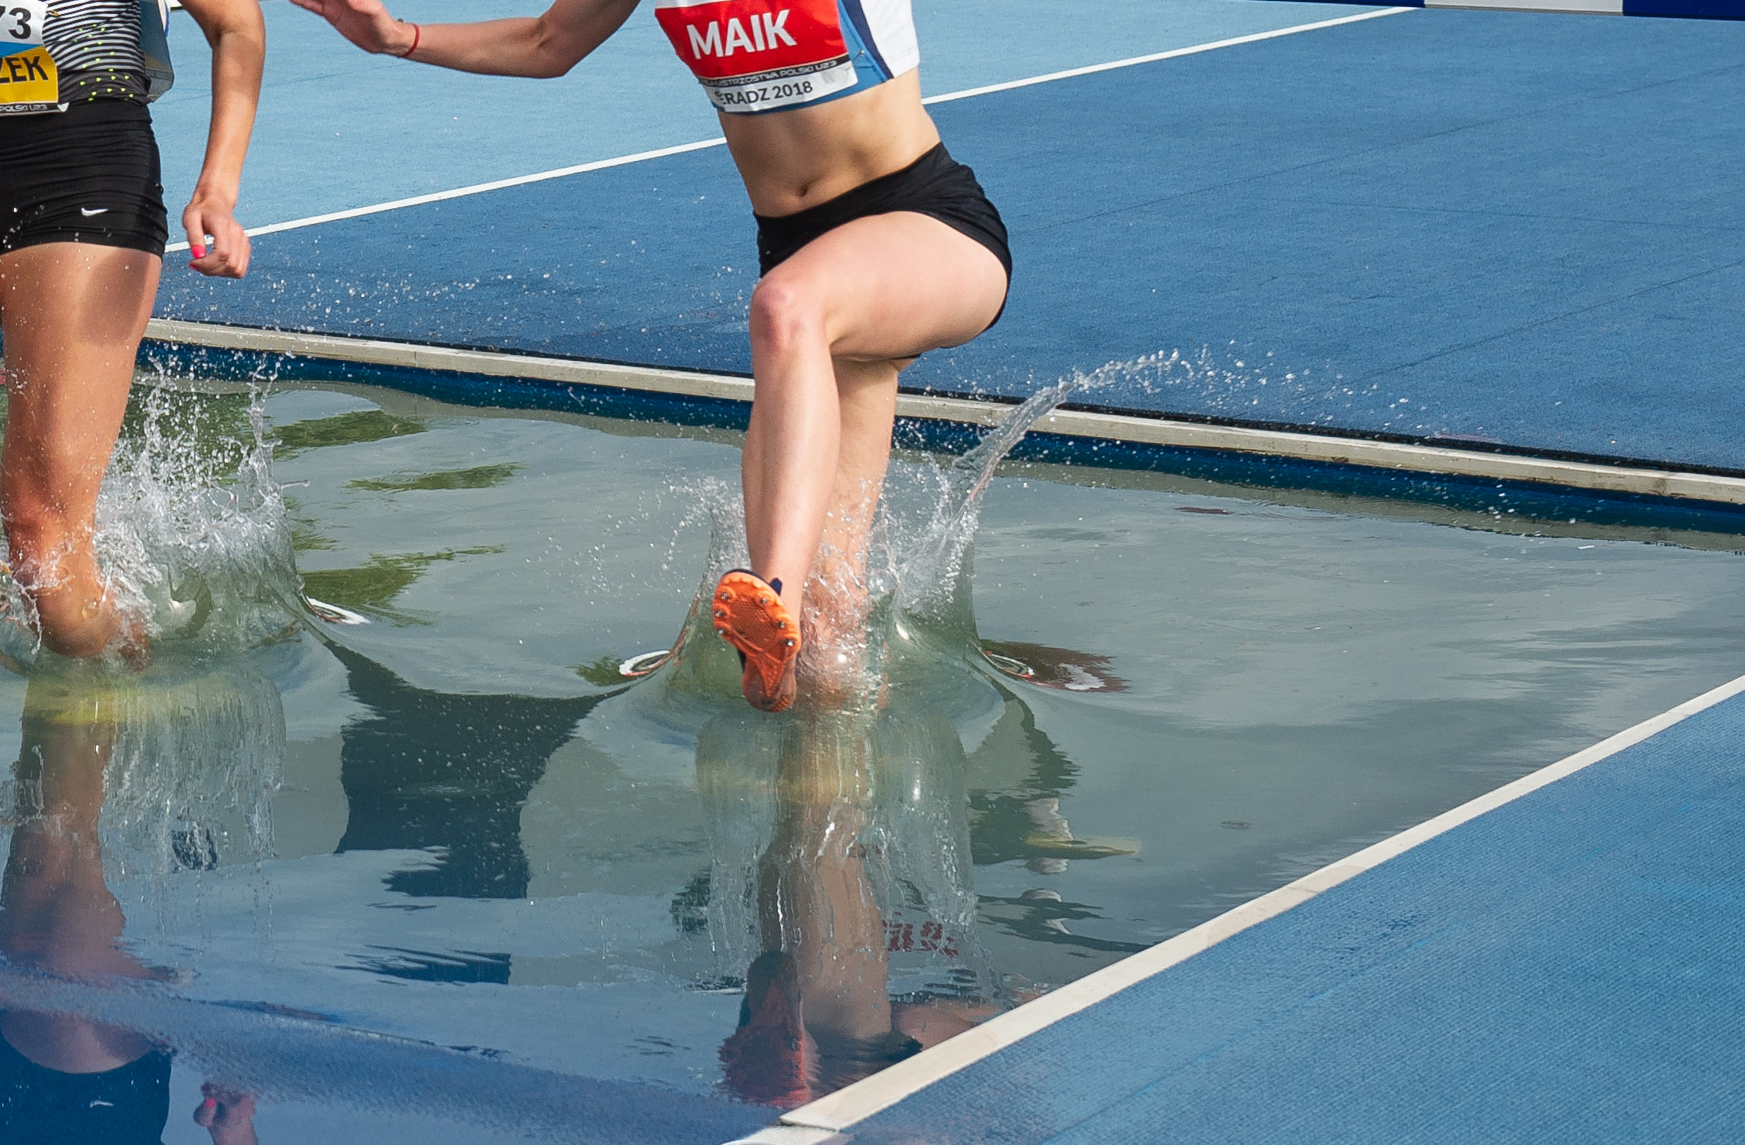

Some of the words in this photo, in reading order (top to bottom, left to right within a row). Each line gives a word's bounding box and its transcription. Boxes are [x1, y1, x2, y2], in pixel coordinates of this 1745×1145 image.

[686, 8, 798, 61] MAIK
[779, 65, 814, 76] POLSKI
[815, 60, 838, 70] U23
[772, 80, 814, 100] 2018
